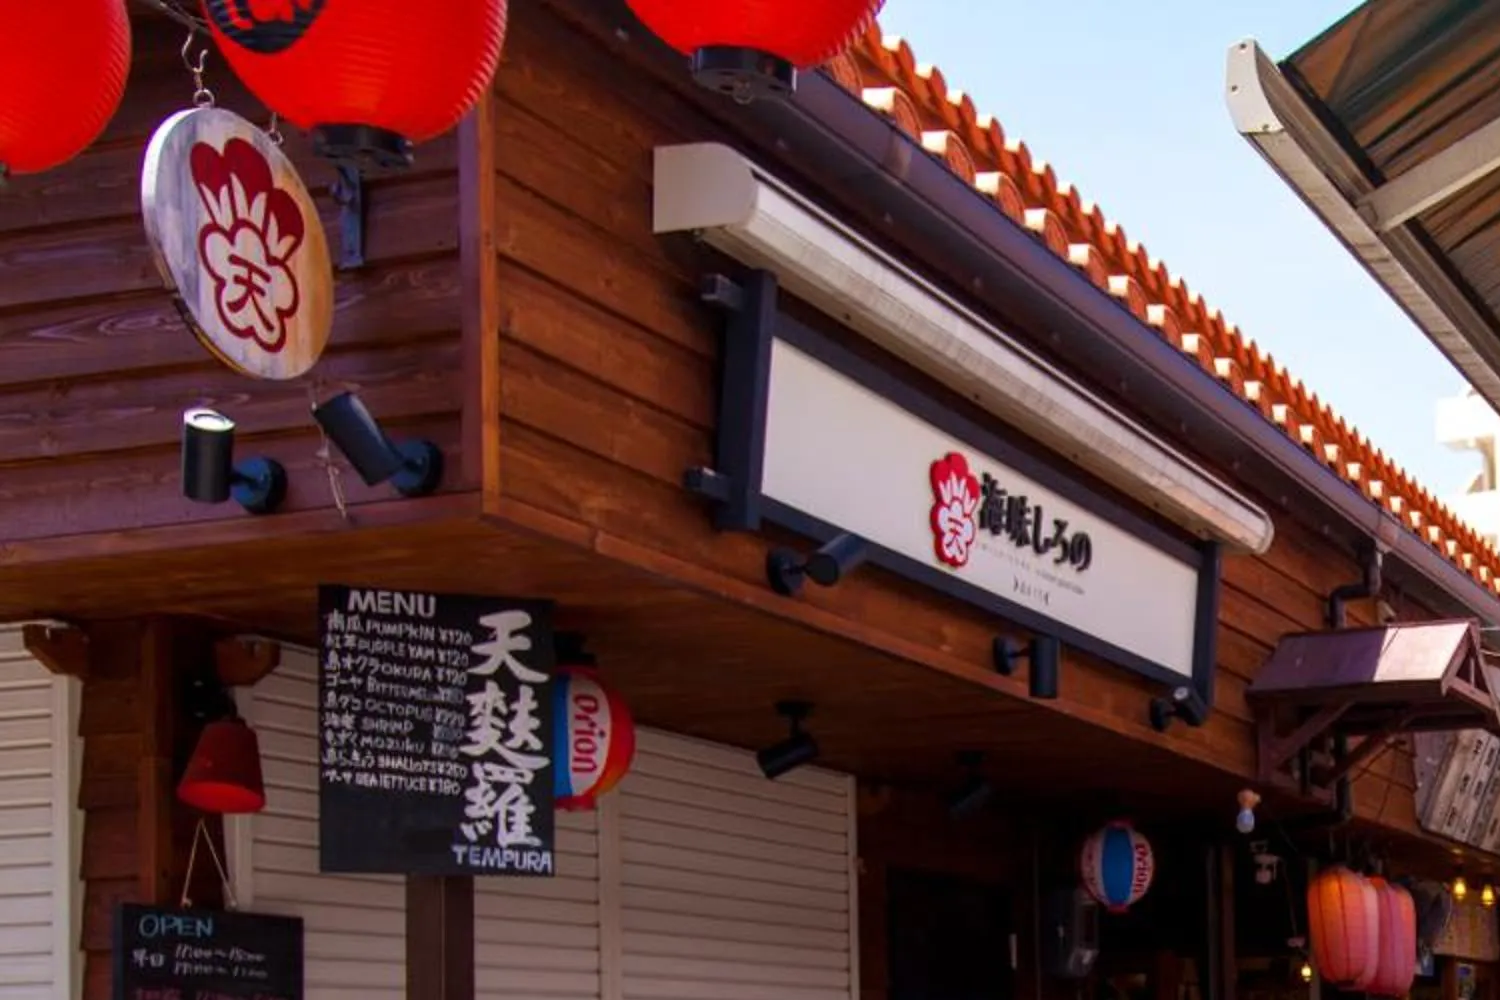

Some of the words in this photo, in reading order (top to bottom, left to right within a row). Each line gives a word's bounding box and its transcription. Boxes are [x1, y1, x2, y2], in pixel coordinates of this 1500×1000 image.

[347, 589, 438, 619] MENU
[572, 694, 607, 773] Orion
[451, 844, 552, 874] TEMPURA
[137, 912, 215, 939] OPEN
